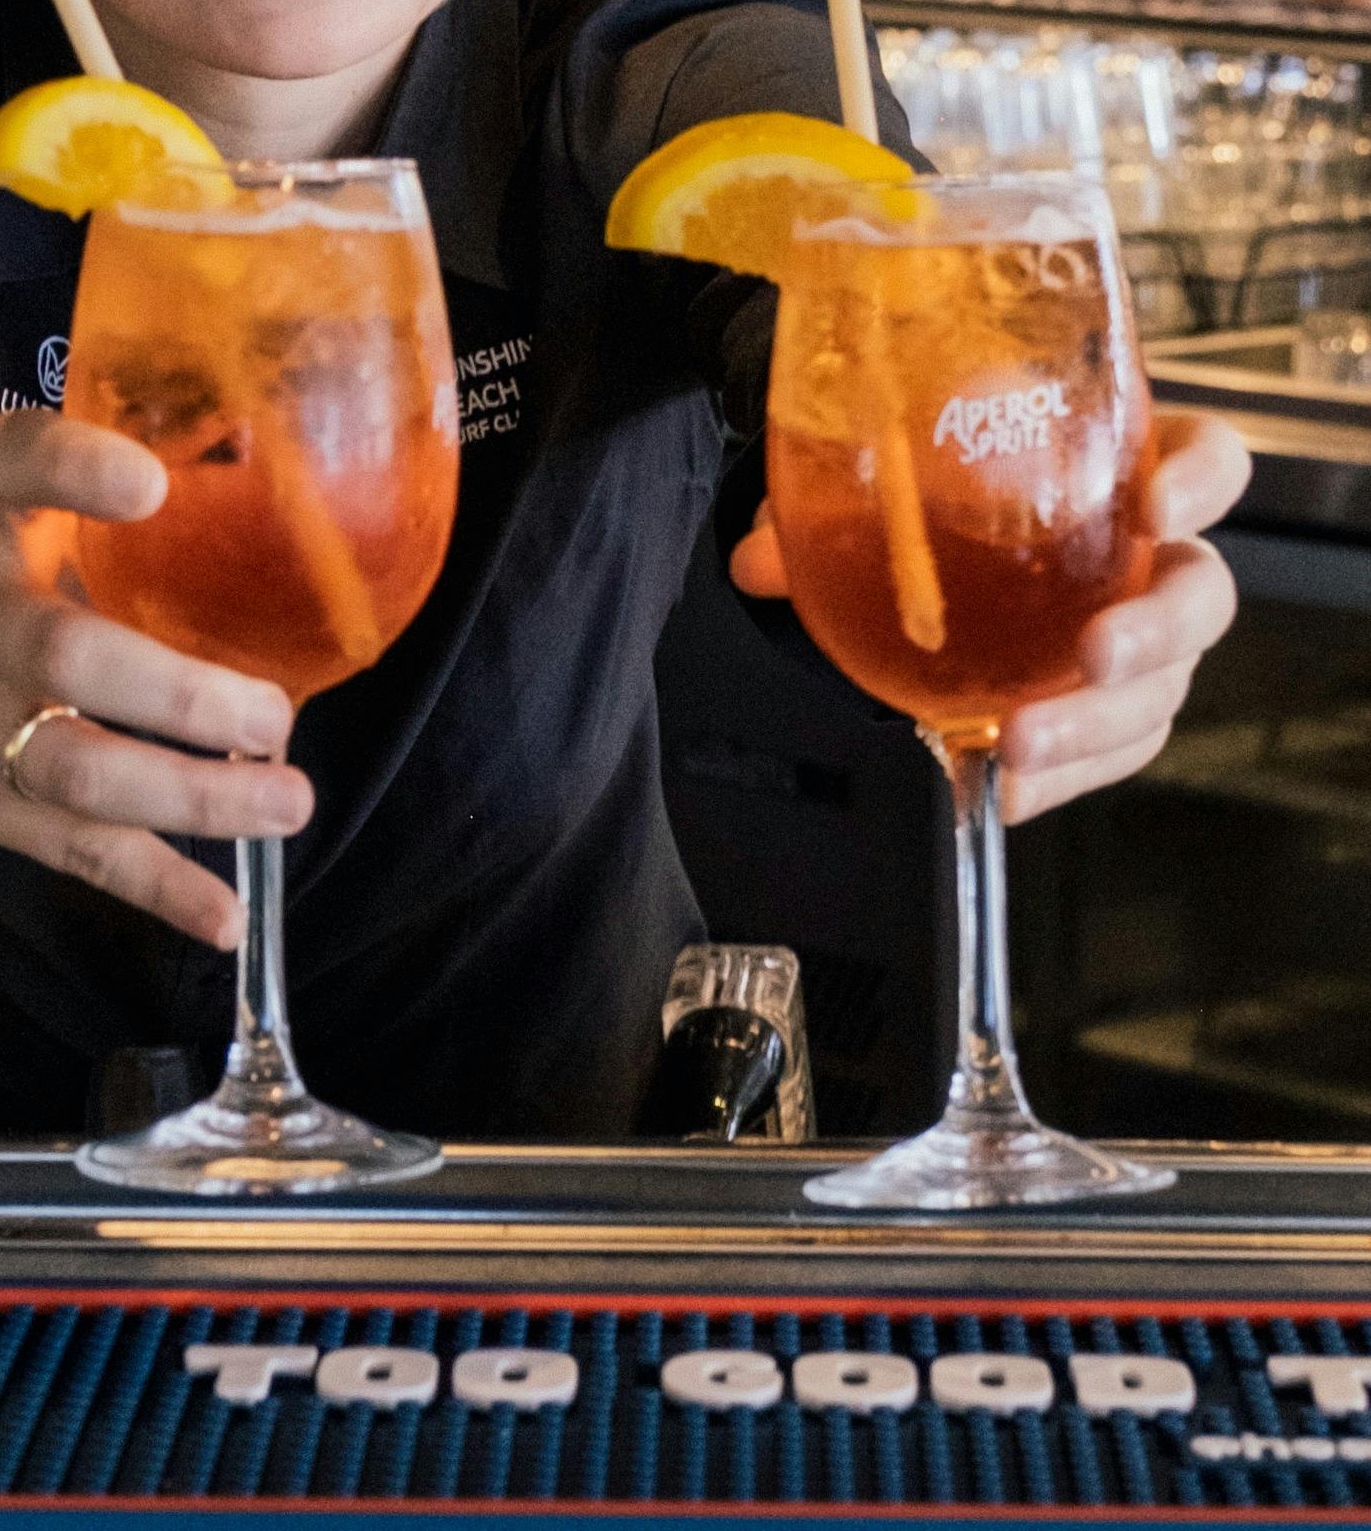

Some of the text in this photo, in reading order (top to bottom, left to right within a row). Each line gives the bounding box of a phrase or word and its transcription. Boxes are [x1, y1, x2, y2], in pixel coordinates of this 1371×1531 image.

[932, 380, 1073, 447] APEROL
[183, 1342, 580, 1412] TOO
[659, 1345, 1197, 1419] GOOD
